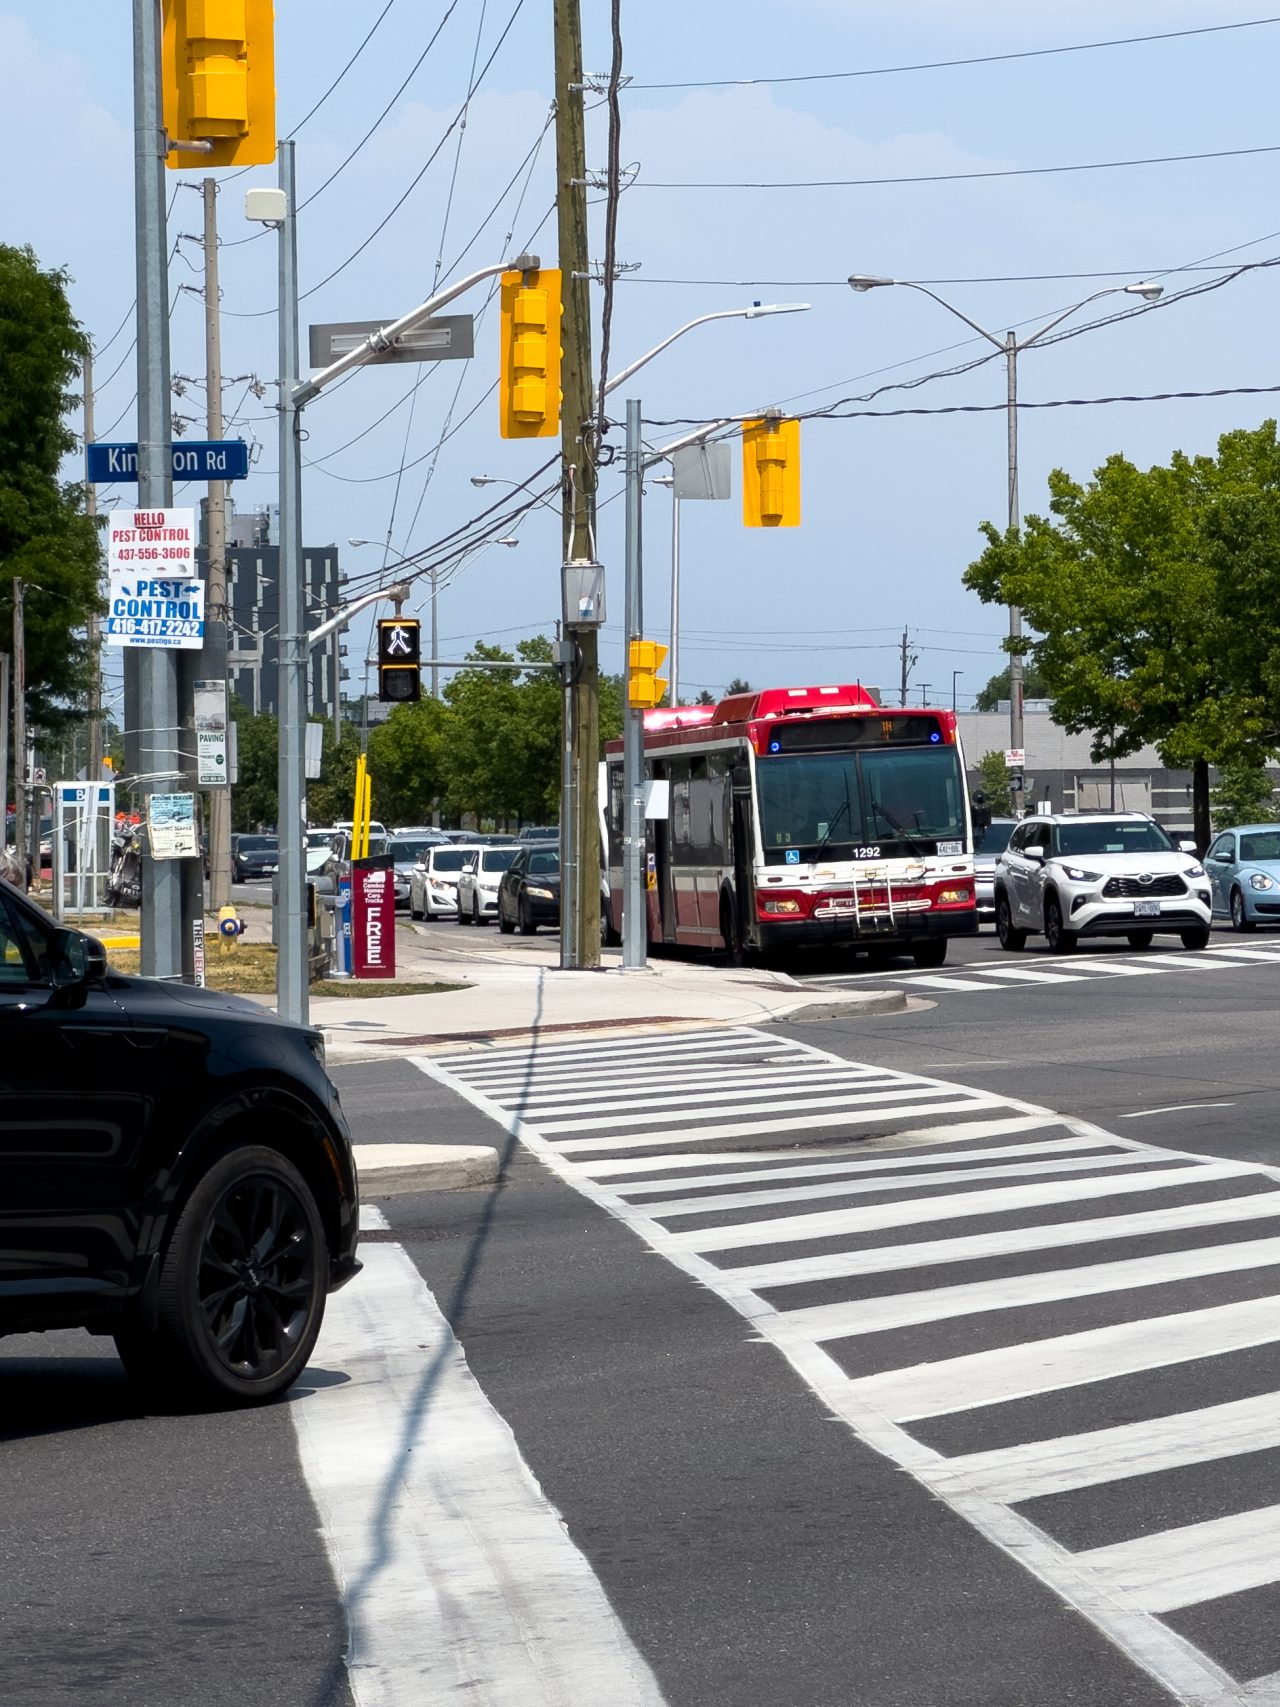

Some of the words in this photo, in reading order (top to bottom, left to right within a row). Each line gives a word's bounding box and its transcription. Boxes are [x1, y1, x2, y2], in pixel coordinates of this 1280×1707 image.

[108, 447, 198, 473] Kinon
[206, 450, 227, 471] Rd
[134, 512, 165, 526] HELLO
[112, 529, 137, 543] PEST
[138, 528, 190, 542] CONTROL
[117, 547, 190, 560] 437-556-3606
[136, 580, 184, 598] PEST
[113, 598, 201, 620] CONTROL
[111, 618, 200, 637] 416-417-2242
[199, 733, 224, 743] PAVING
[853, 846, 881, 858] 1292
[366, 907, 382, 964] FREE
